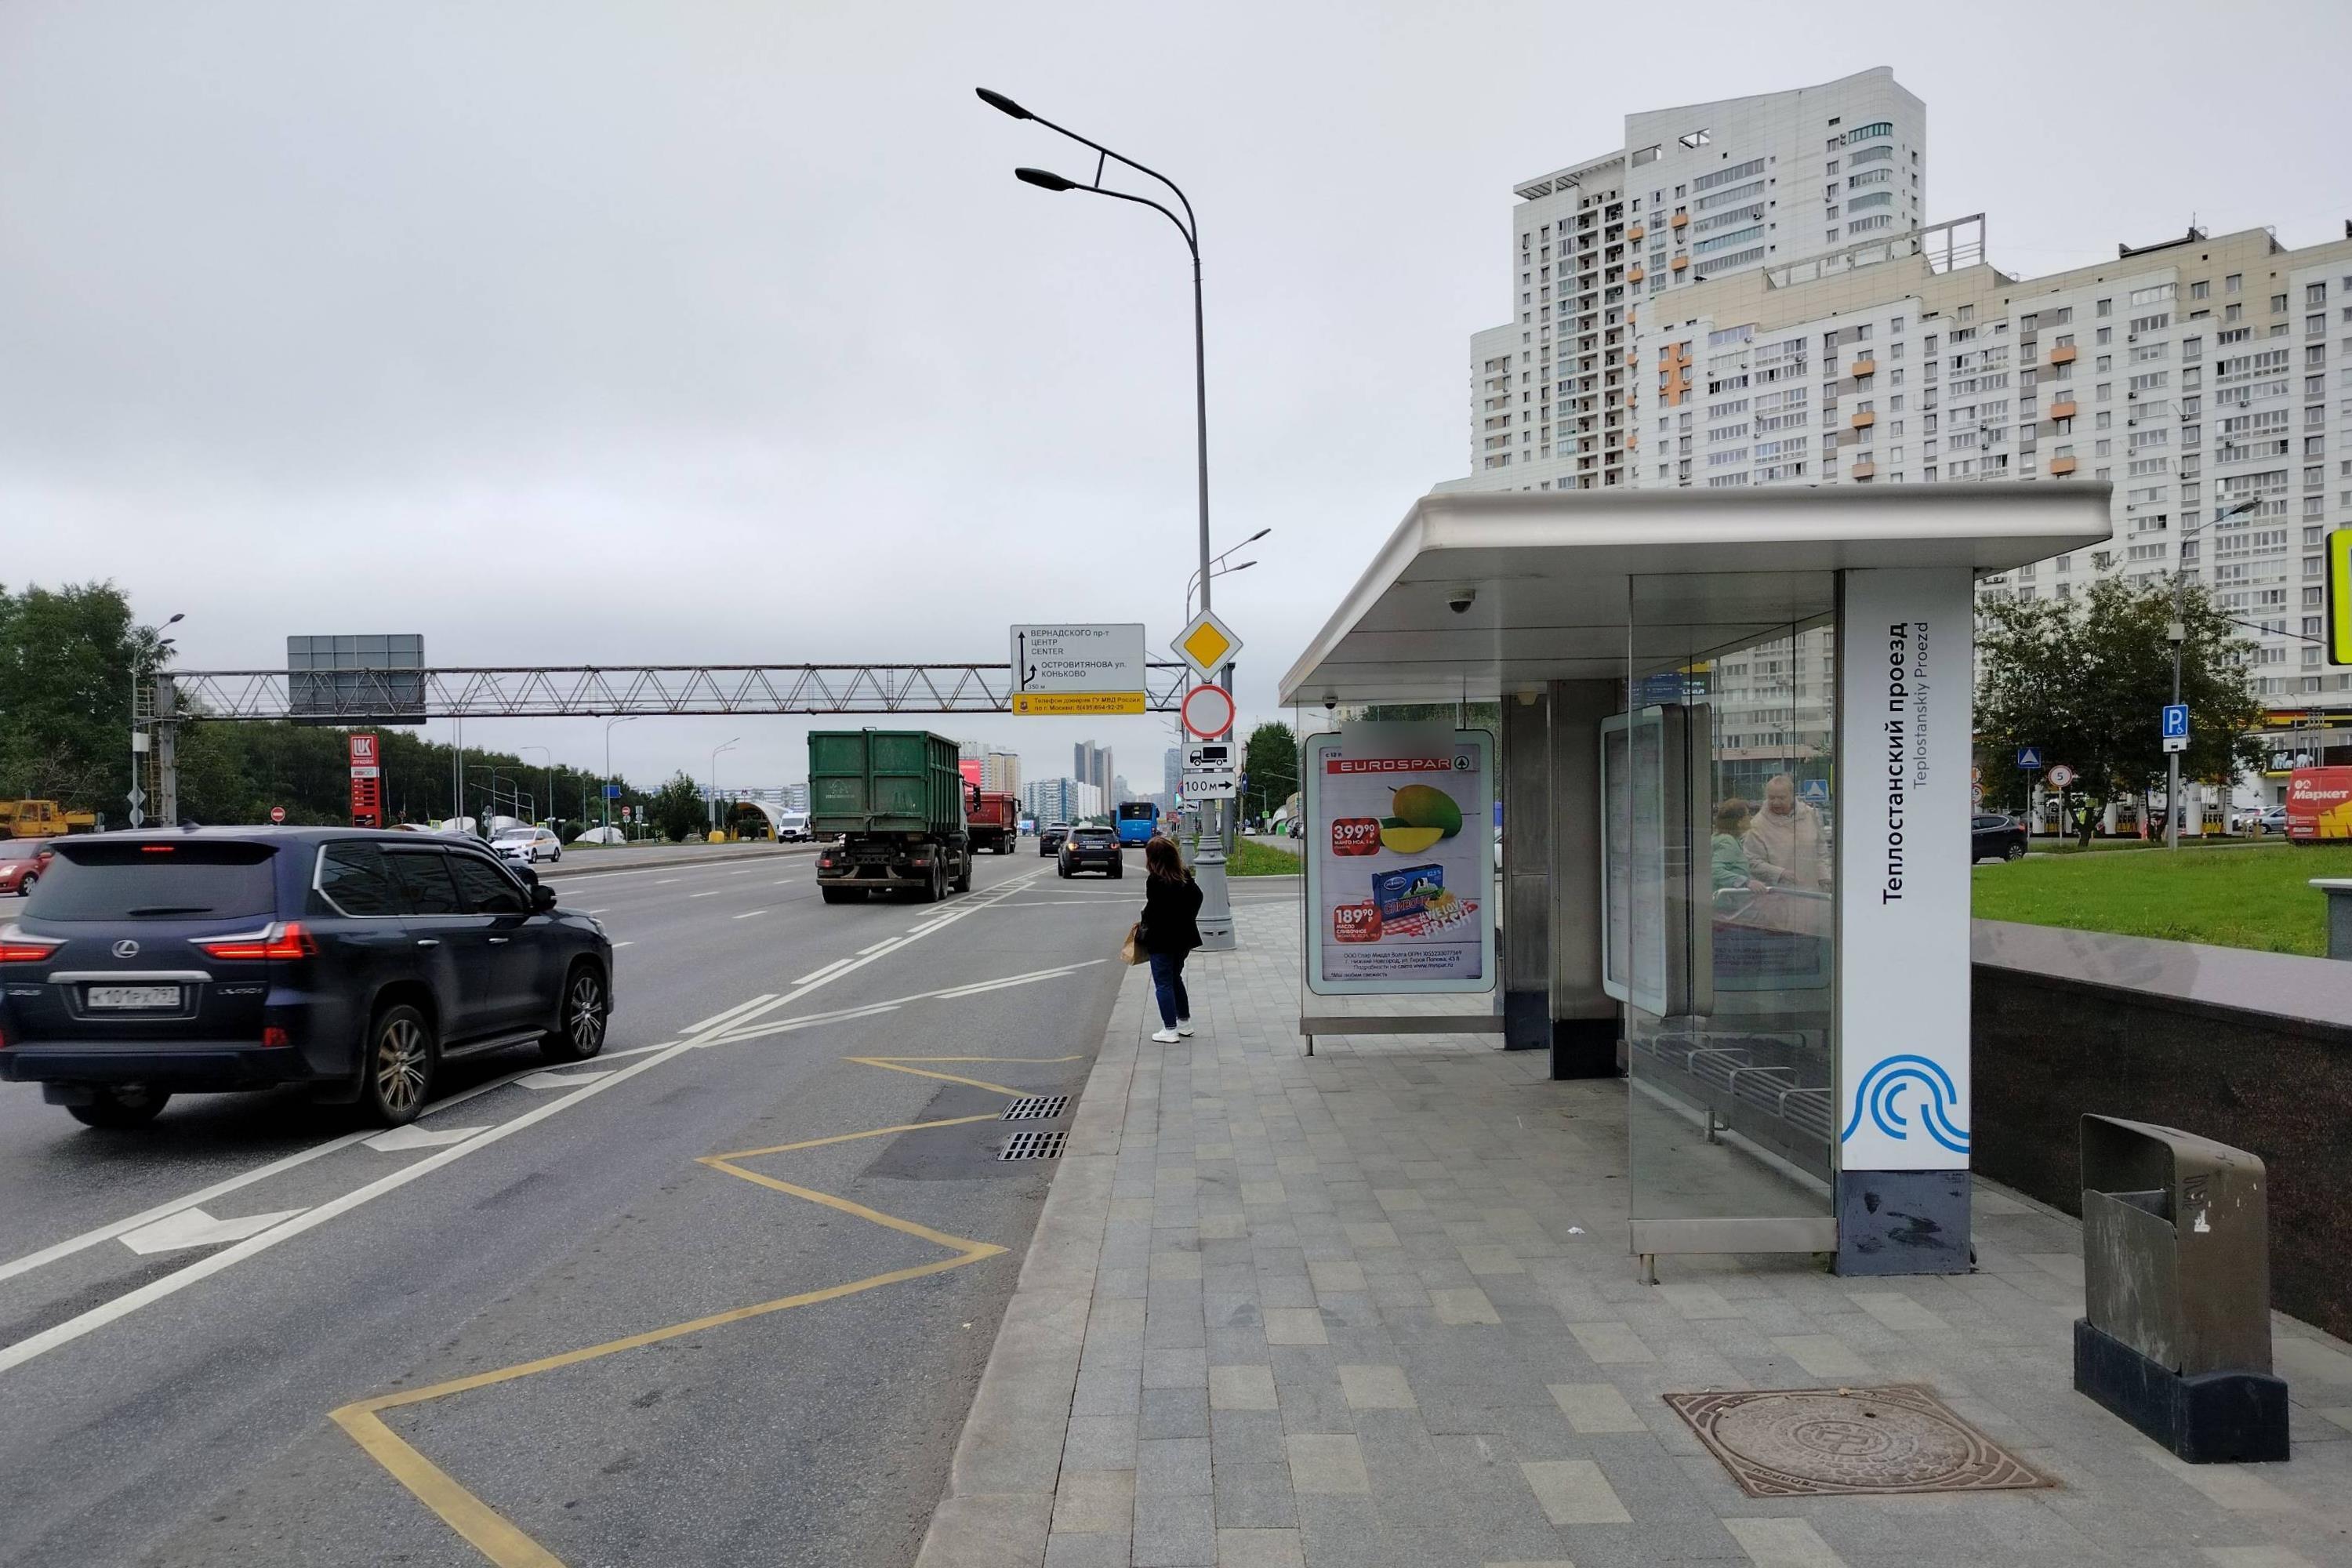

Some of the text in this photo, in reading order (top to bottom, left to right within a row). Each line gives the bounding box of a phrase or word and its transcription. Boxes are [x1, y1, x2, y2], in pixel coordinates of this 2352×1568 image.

[1913, 622, 1930, 789] Teplostanskiy Proezd
[1340, 759, 1450, 771] EUROSPAR
[1883, 622, 1908, 905] Теплостанский проезд
[2292, 790, 2350, 800] Маркет
